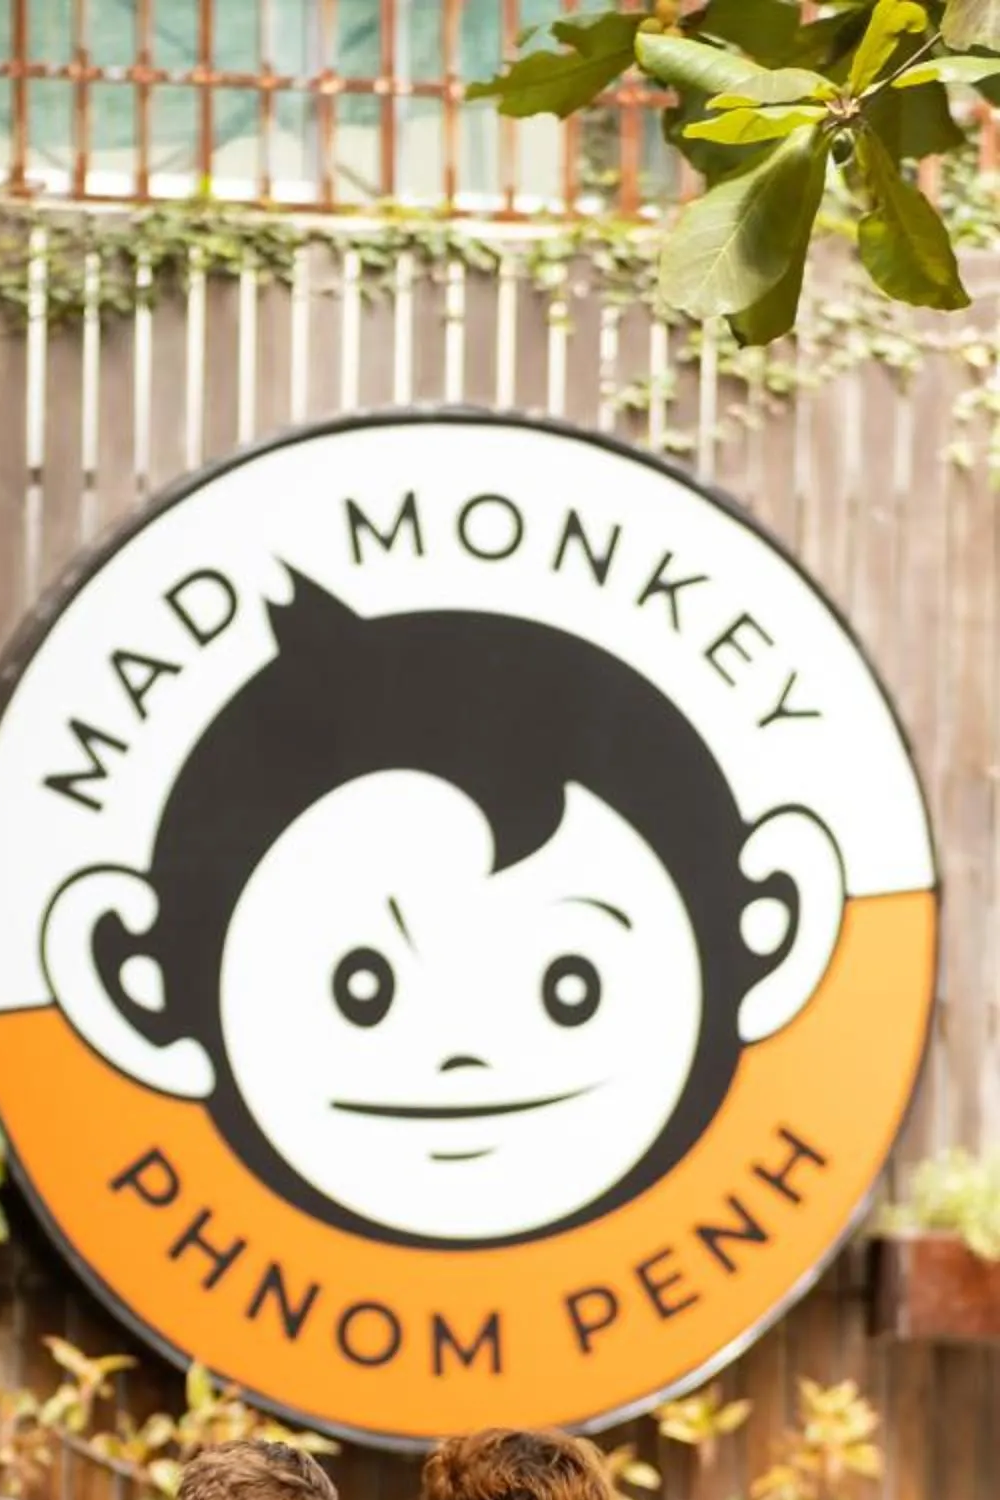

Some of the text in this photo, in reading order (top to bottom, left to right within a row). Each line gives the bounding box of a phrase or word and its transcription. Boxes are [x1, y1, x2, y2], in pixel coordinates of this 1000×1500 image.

[41, 490, 822, 812] MAD MONKEY
[108, 1125, 830, 1378] PHNOM PENH
